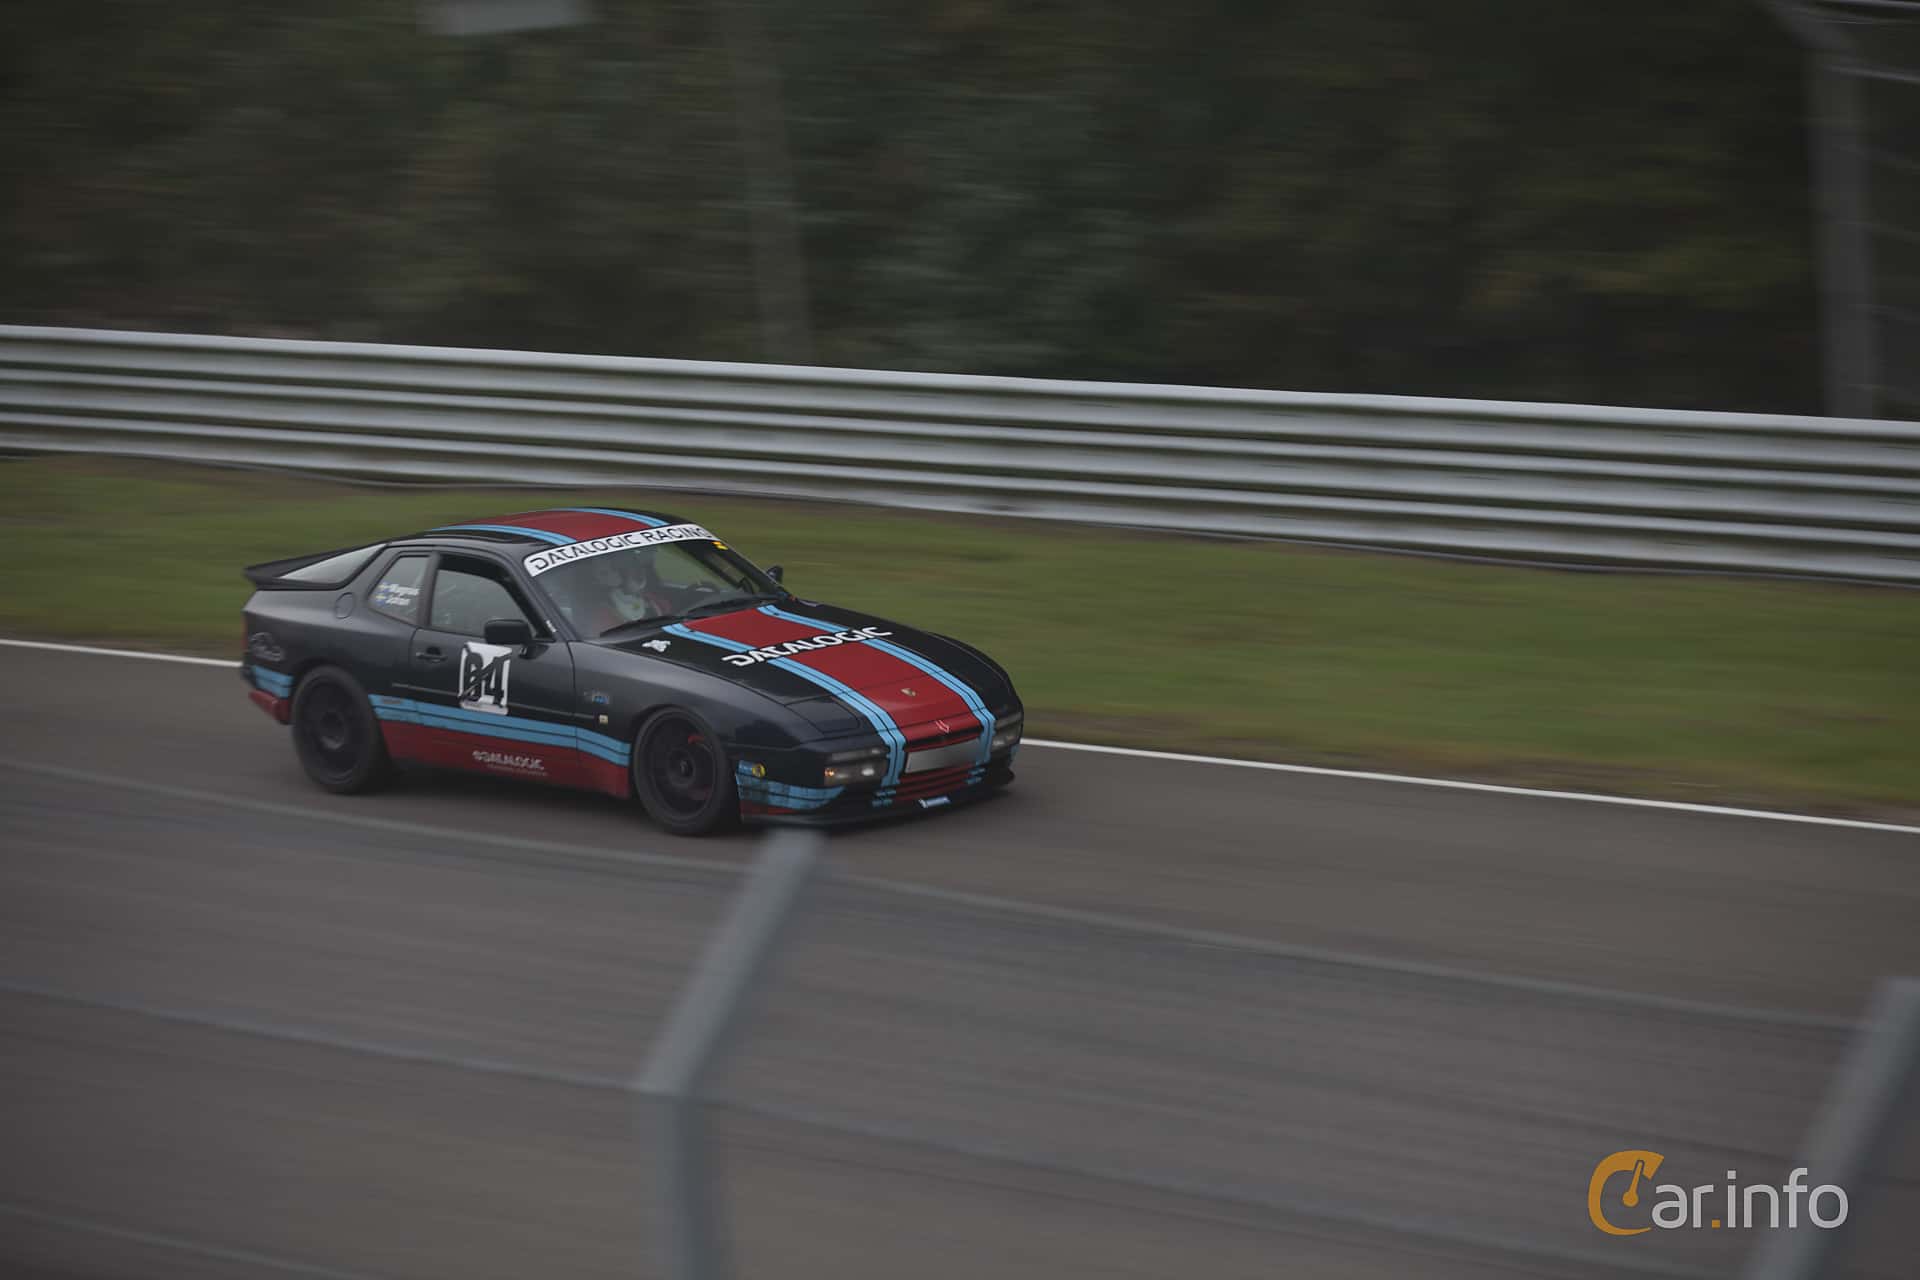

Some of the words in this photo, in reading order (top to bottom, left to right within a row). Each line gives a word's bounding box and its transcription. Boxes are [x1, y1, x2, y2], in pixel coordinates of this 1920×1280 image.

[529, 534, 641, 571] DATALOGIC
[642, 527, 713, 543] RACING
[721, 626, 893, 667] DATALOGIC
